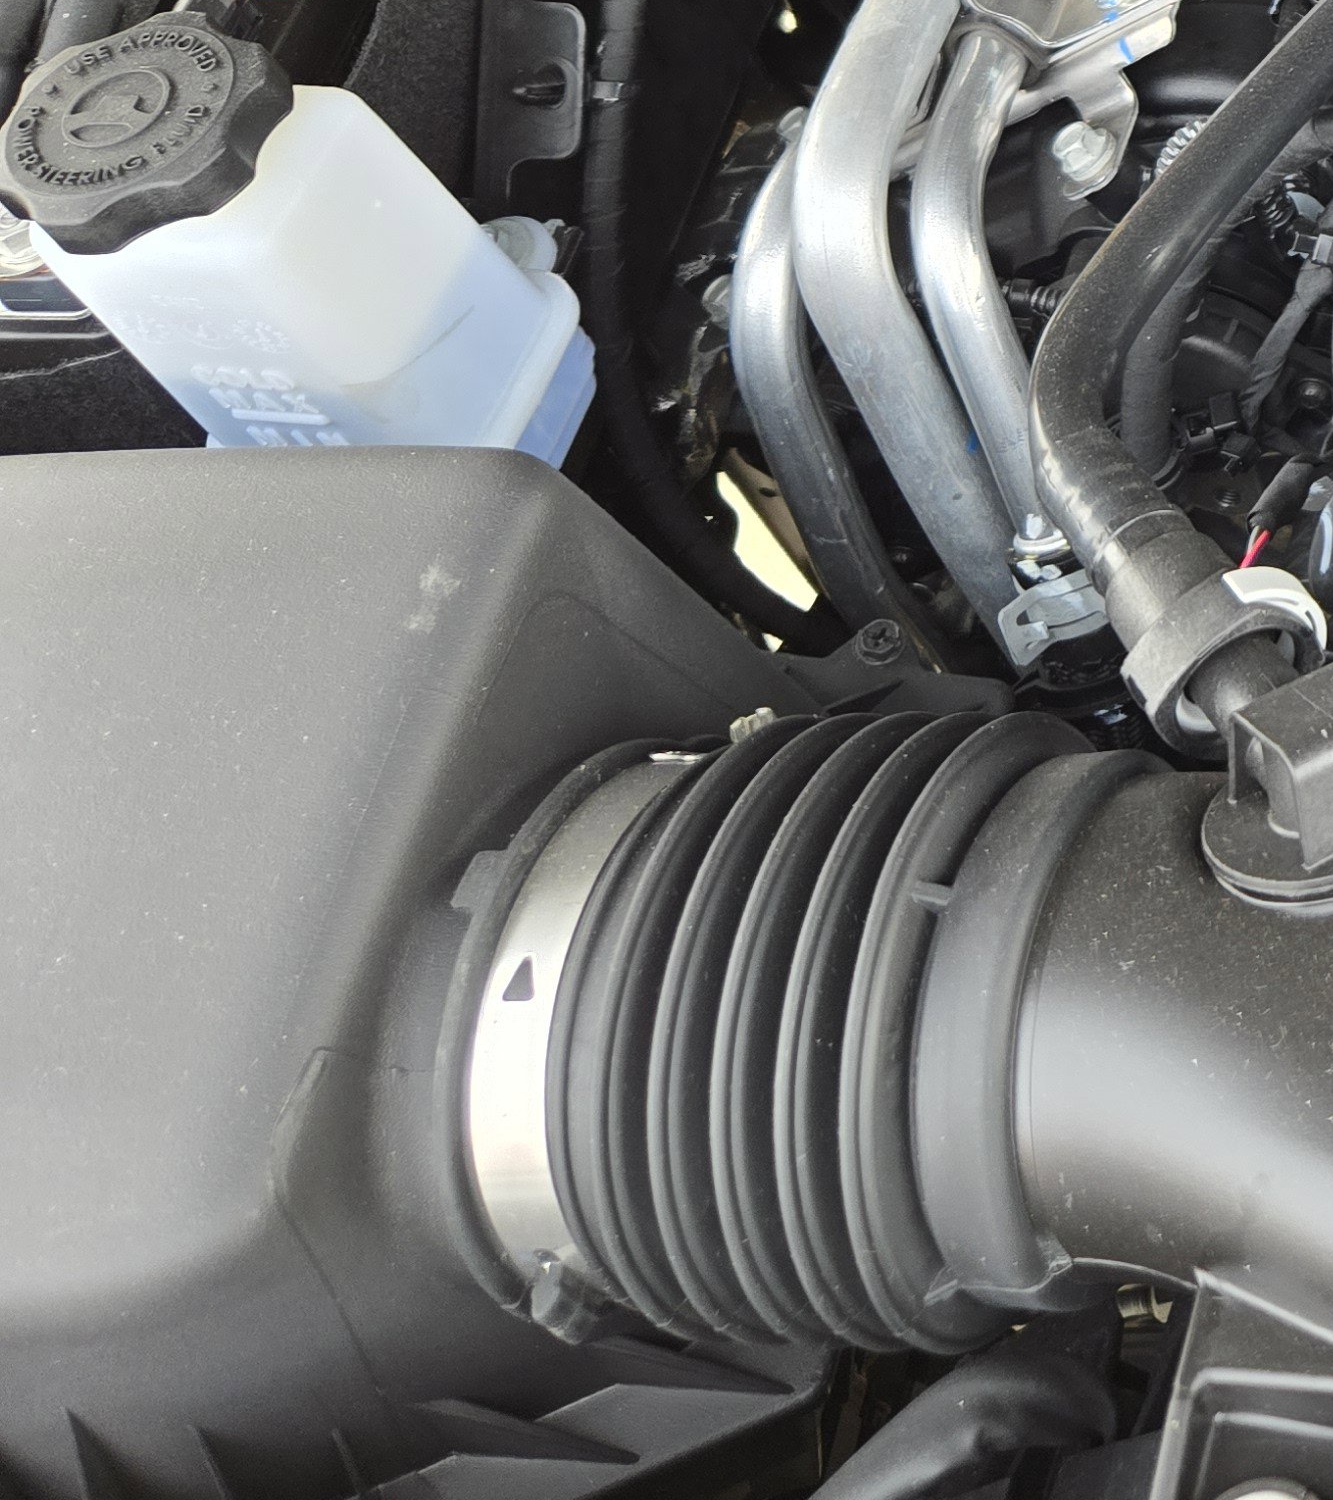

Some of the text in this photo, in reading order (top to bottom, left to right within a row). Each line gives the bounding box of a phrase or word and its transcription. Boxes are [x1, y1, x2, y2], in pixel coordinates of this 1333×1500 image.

[64, 31, 220, 76] USE APPROVED
[13, 104, 211, 187] POWER STEERING FLUID
[208, 386, 321, 414] MAX
